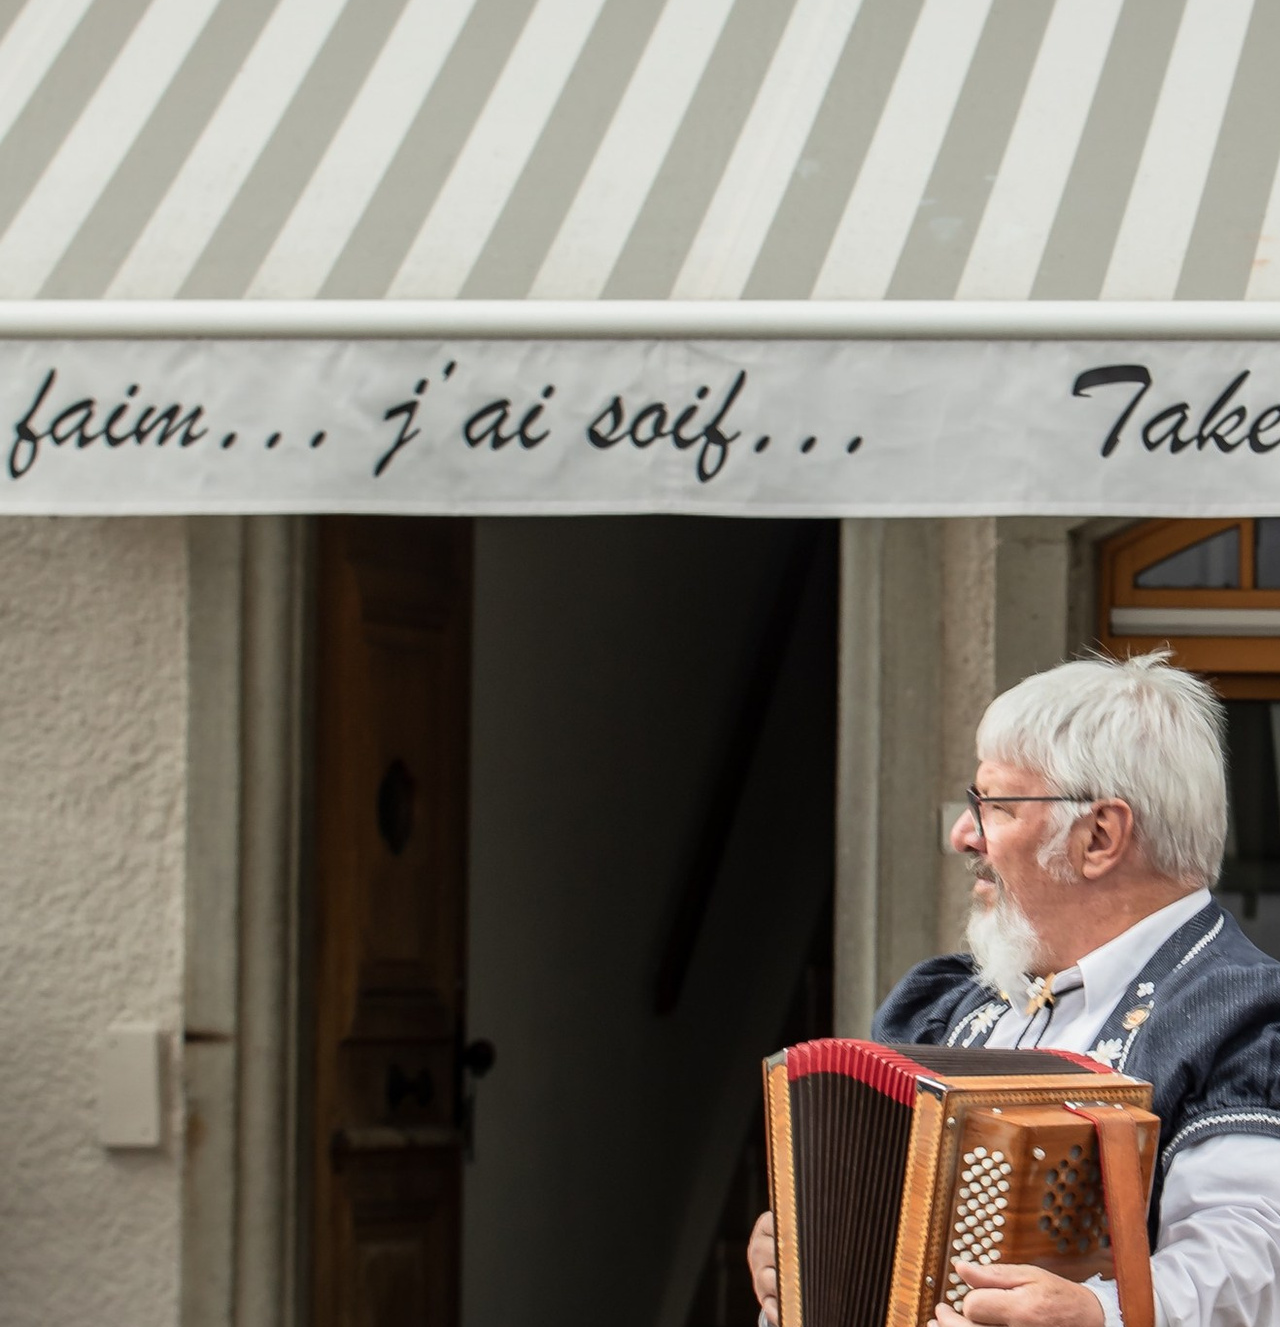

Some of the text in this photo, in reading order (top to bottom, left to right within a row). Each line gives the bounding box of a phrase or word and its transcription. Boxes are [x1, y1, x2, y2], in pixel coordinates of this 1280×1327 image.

[8, 361, 863, 483] faim... j'ai soif...
